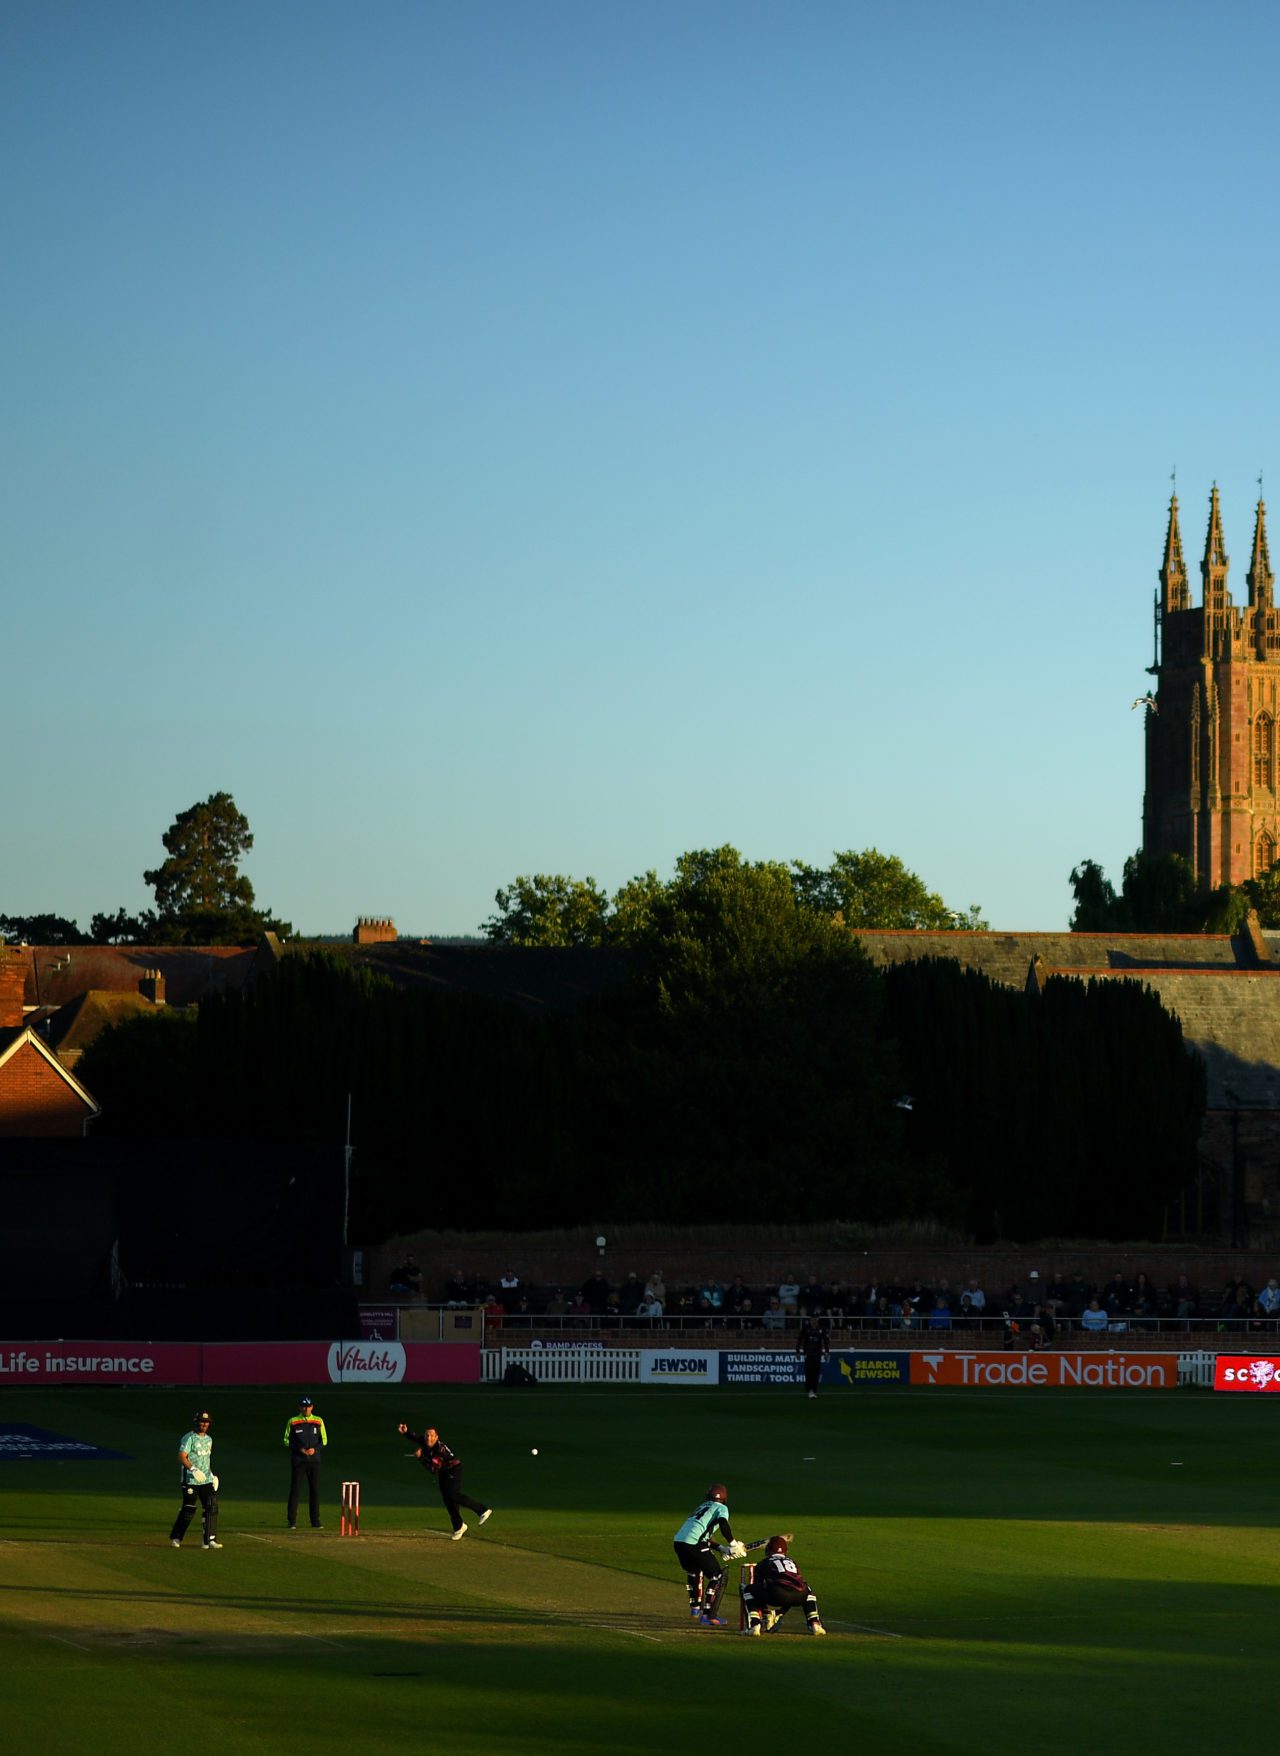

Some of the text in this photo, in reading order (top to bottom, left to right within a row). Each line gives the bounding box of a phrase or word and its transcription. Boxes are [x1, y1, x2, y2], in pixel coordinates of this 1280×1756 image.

[0, 1351, 155, 1373] Life insurance
[336, 1346, 398, 1379] Vitality
[727, 1354, 773, 1363] BUILDING
[855, 1360, 898, 1369] SEARCH
[651, 1358, 708, 1373] JEWSON
[727, 1364, 794, 1373] LANDSCAPING
[954, 1355, 1166, 1386] Trade Nation
[727, 1374, 762, 1383] TIMBER
[769, 1375, 795, 1383] TOOL
[855, 1369, 900, 1379] JEWSON
[773, 1559, 798, 1573] 18
